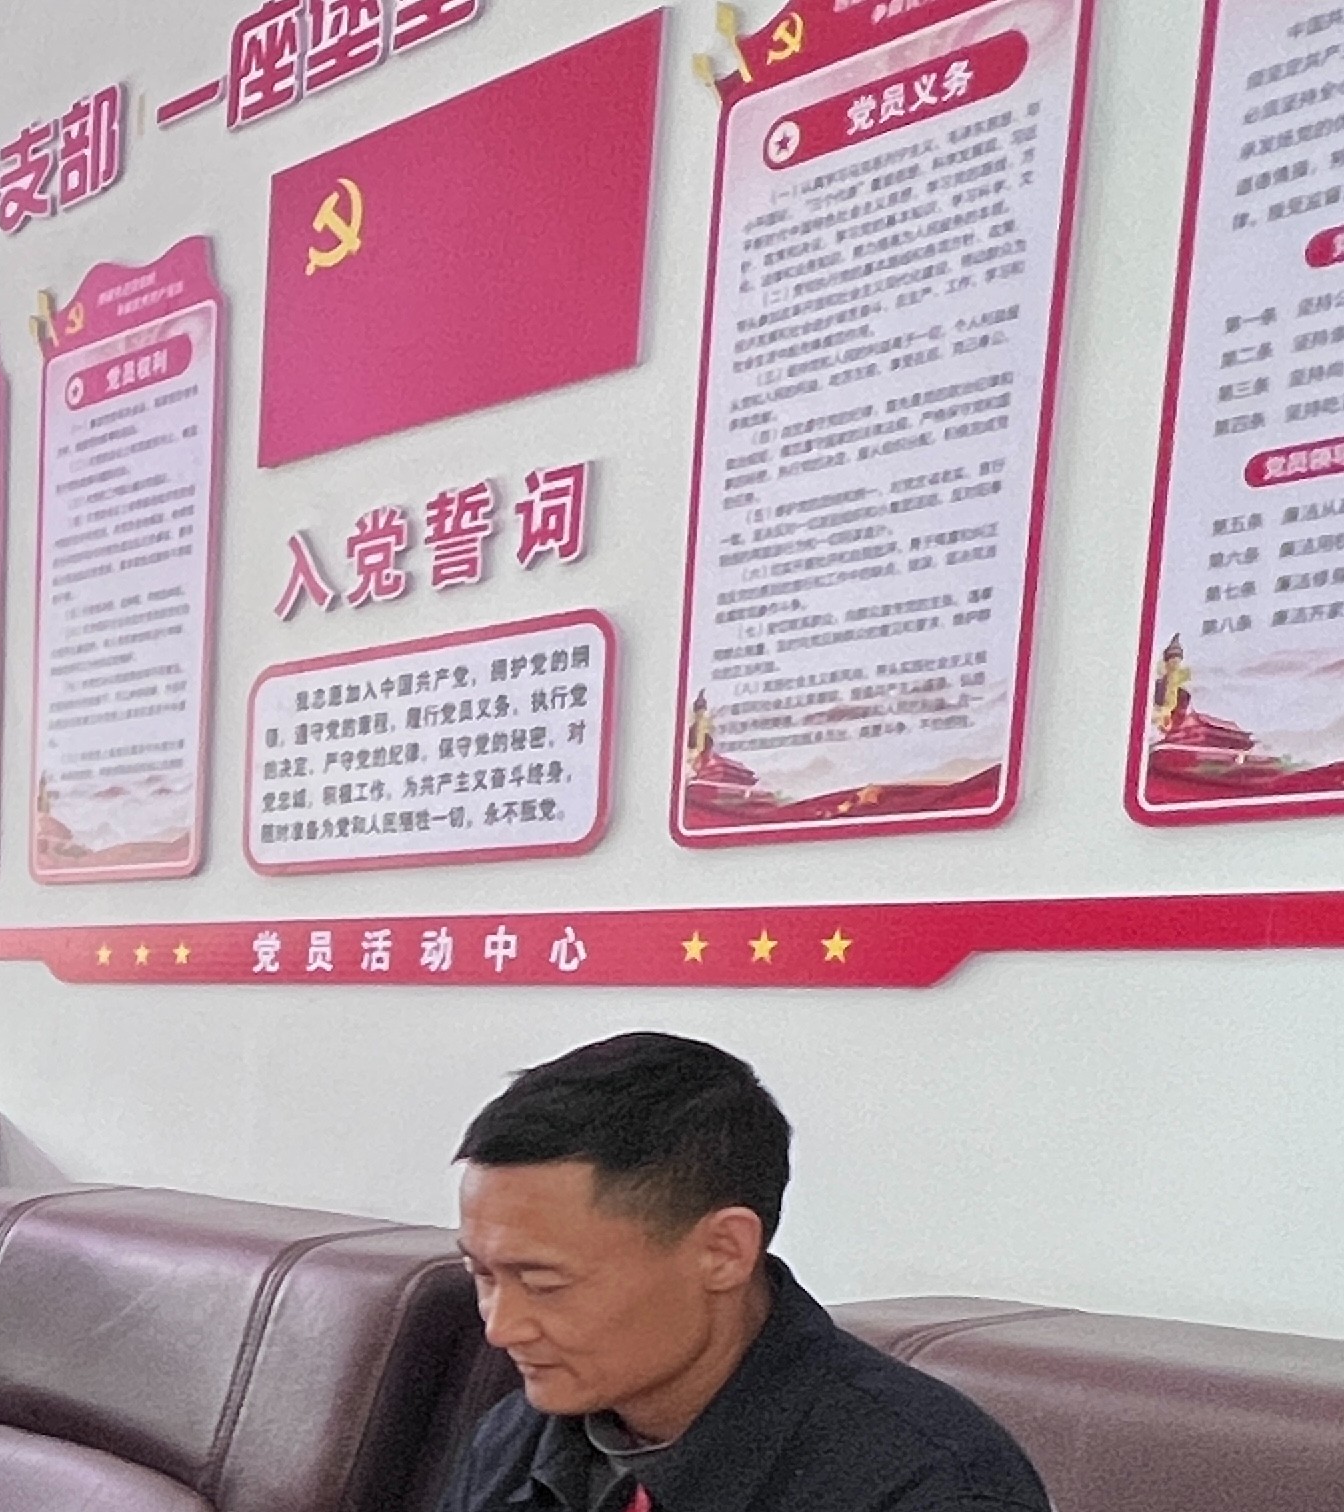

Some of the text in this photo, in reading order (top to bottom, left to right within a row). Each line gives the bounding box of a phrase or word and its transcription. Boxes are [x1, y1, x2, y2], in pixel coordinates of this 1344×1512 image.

[846, 58, 974, 136] 党员义务
[105, 348, 169, 393] 党员权利
[274, 462, 588, 621] 入党誓词
[252, 925, 587, 973] 党员活动中心
